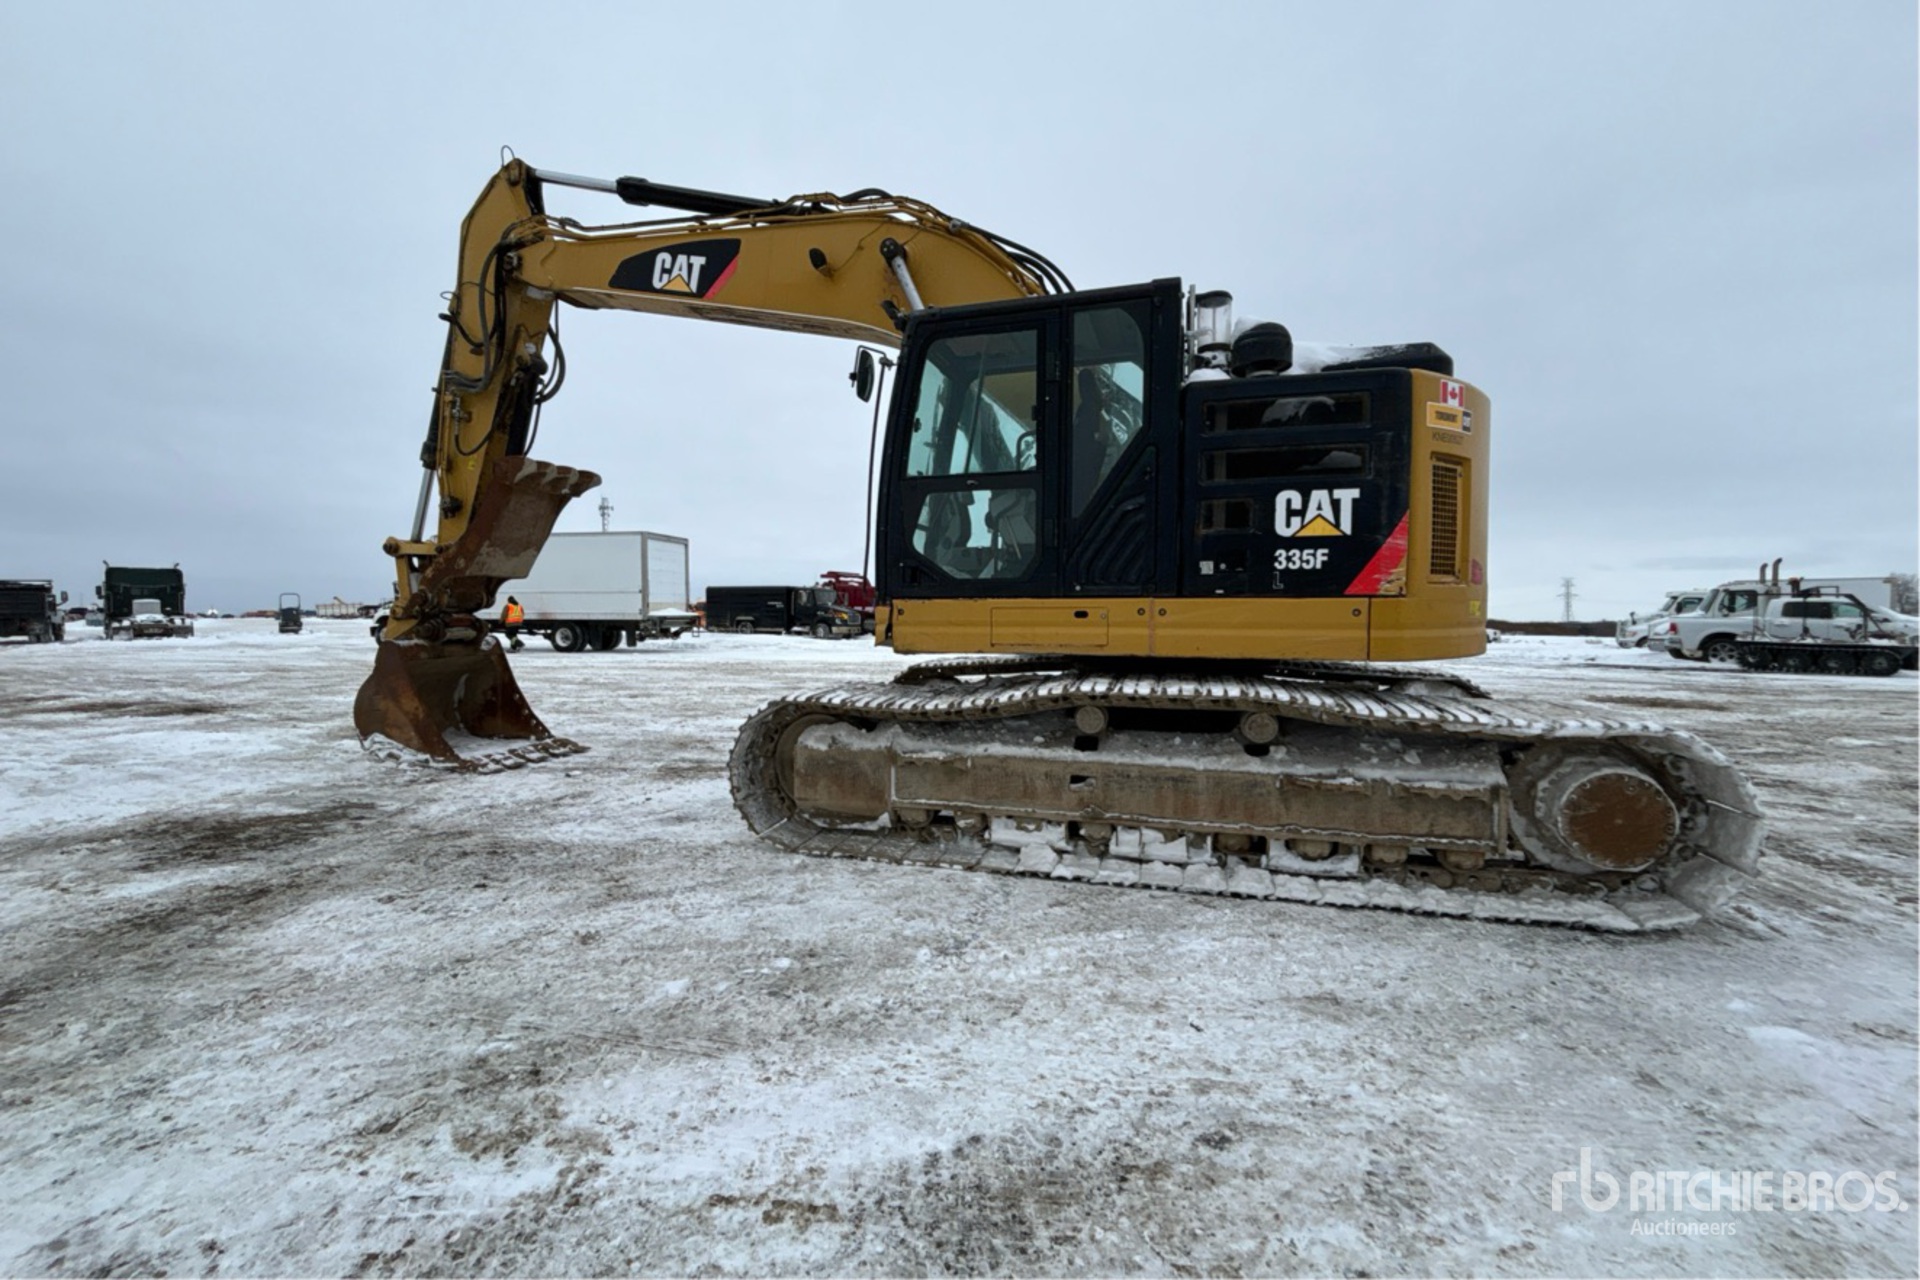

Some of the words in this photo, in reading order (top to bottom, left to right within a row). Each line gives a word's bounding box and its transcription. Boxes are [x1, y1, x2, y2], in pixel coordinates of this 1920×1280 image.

[652, 251, 707, 294] CAT
[1274, 488, 1361, 538] CAT
[1273, 548, 1330, 570] 335F
